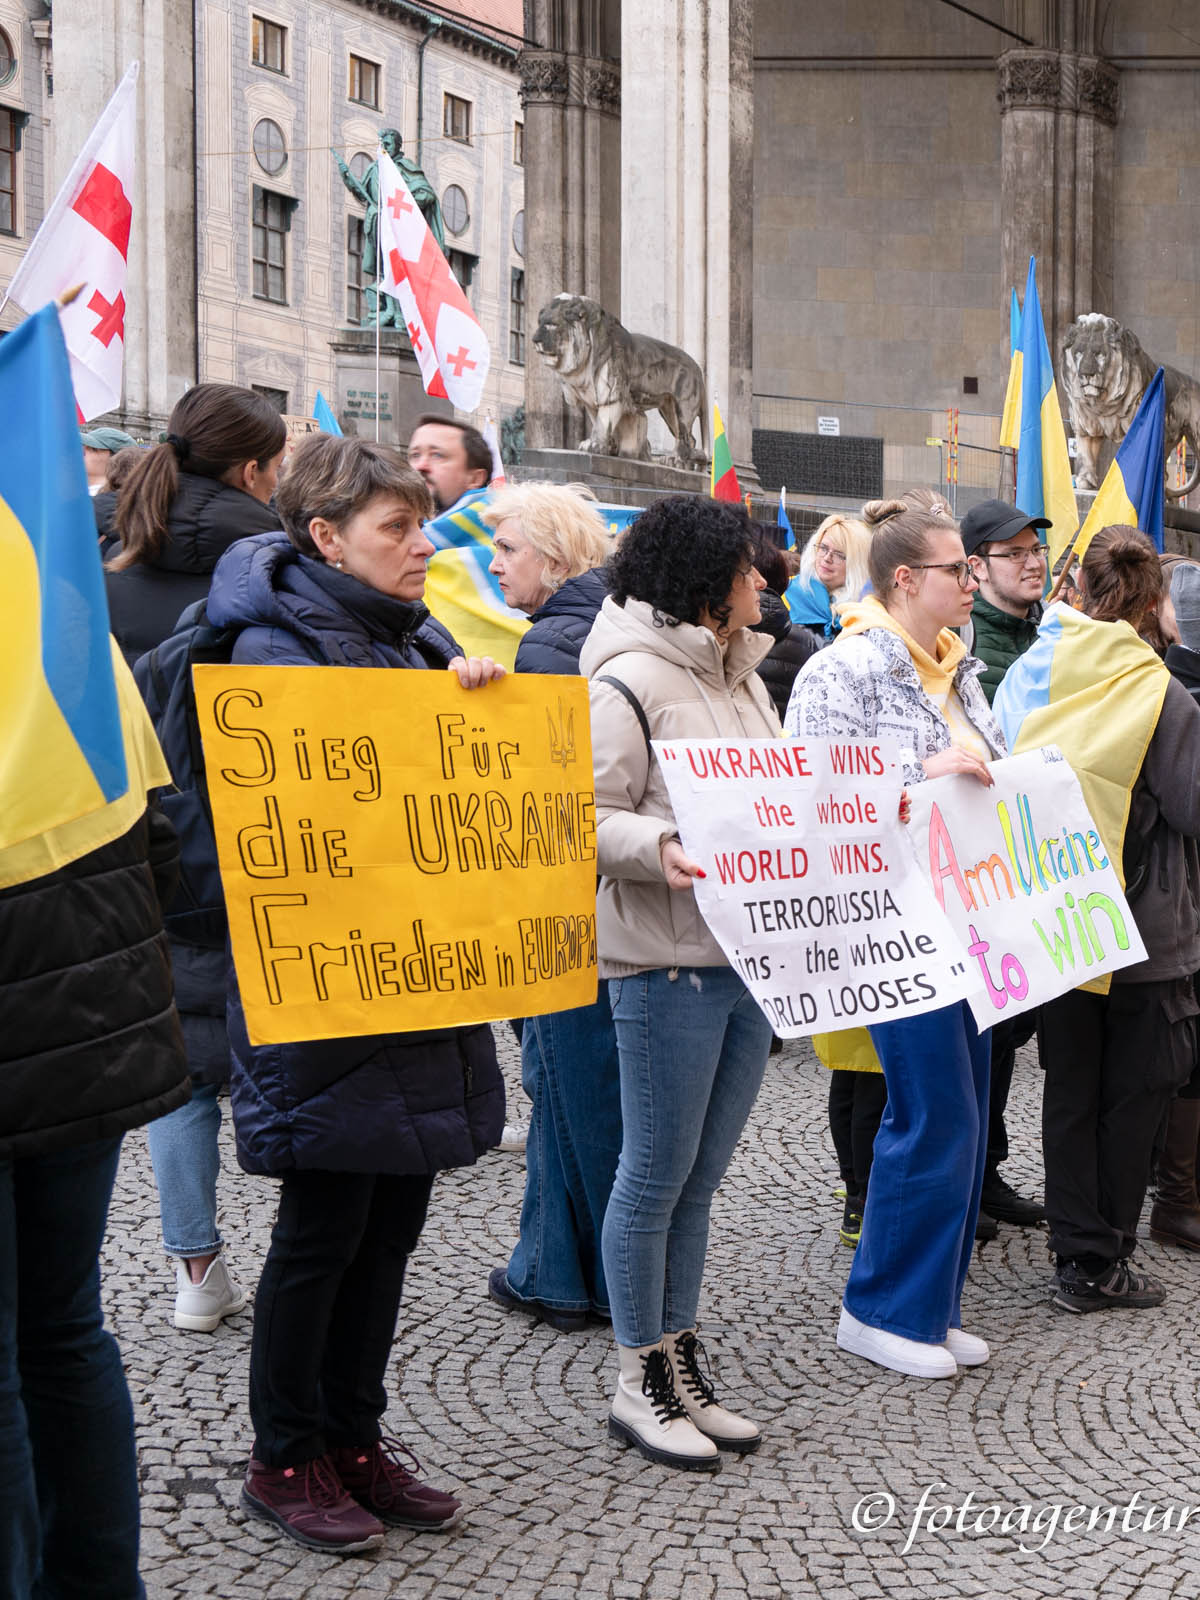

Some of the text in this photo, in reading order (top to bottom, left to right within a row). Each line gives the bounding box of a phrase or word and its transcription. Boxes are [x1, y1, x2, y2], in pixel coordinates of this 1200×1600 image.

[753, 794, 877, 829] the whole
[714, 843, 889, 885] WORLD WINS.
[928, 792, 1109, 913] Arm Ukraine
[743, 889, 902, 934] TERRORUSSIA
[495, 945, 514, 988] in
[518, 913, 598, 985] EUROPA
[733, 949, 771, 981] ins
[805, 939, 840, 973] the
[850, 930, 937, 967] whole
[967, 890, 1130, 1010] to win
[762, 991, 818, 1030] ORLD
